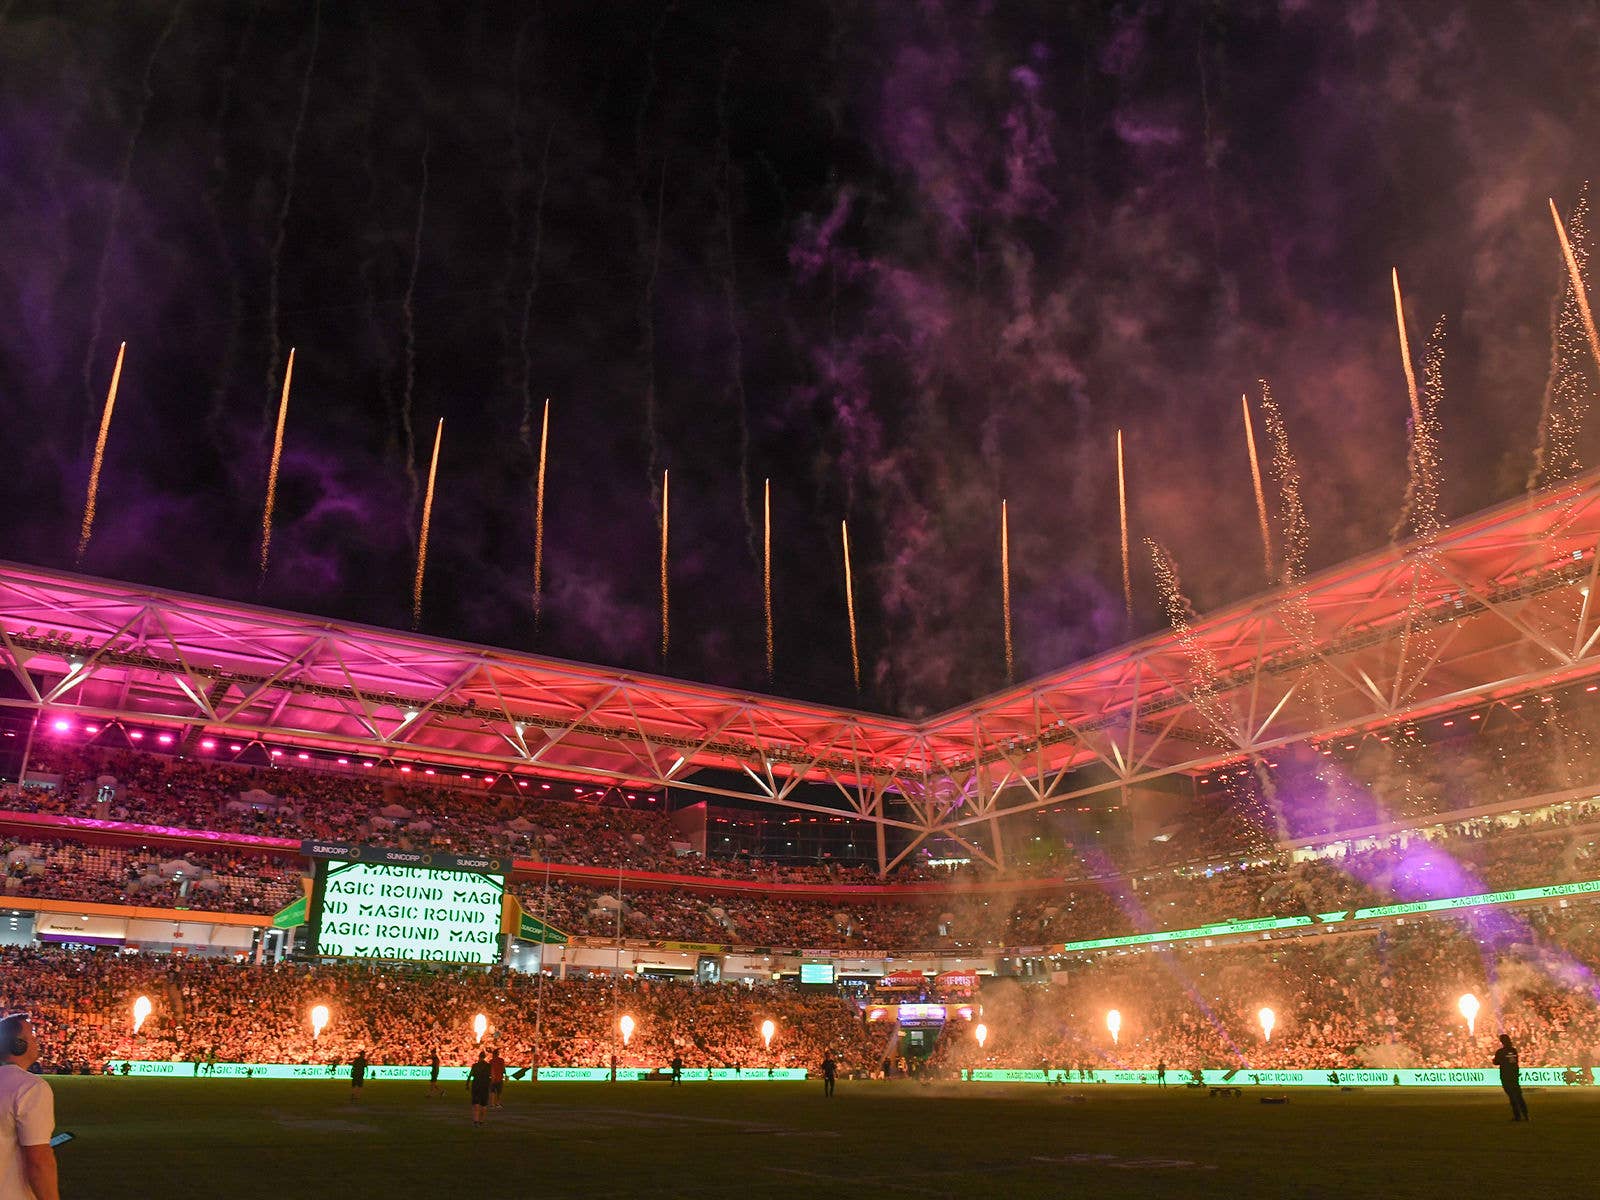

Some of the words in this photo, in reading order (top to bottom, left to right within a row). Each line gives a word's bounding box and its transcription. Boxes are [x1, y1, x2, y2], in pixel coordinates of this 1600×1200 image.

[313, 846, 348, 854] SUNCORP
[364, 864, 421, 878] MAGIC
[381, 884, 443, 900] ROUND
[1543, 885, 1575, 896] MAGIC
[1451, 897, 1480, 906] MAGIC
[1483, 893, 1515, 902] ROUND
[359, 904, 418, 919] MAGIC
[425, 908, 485, 923] ROUND
[1370, 905, 1396, 915] MAGIC
[1398, 903, 1427, 913] ROUND
[377, 925, 439, 940] ROUND
[355, 946, 414, 960] MAGIC
[421, 949, 480, 963] ROUND
[939, 975, 976, 985] CHEMIST
[140, 1064, 173, 1073] ROUND
[235, 1066, 267, 1075] ROND
[294, 1068, 321, 1076] MAGIC
[381, 1069, 408, 1077] MAGIC
[410, 1069, 433, 1077] ROUN
[540, 1070, 562, 1078] MAGIC
[565, 1070, 591, 1078] ROUND
[618, 1070, 635, 1078] AGIC
[1275, 1073, 1303, 1081] ROUND
[1327, 1073, 1355, 1082] MGIC
[1357, 1073, 1388, 1082] ROUND
[1414, 1073, 1446, 1082] MAGIC
[1449, 1073, 1484, 1081] ROUND
